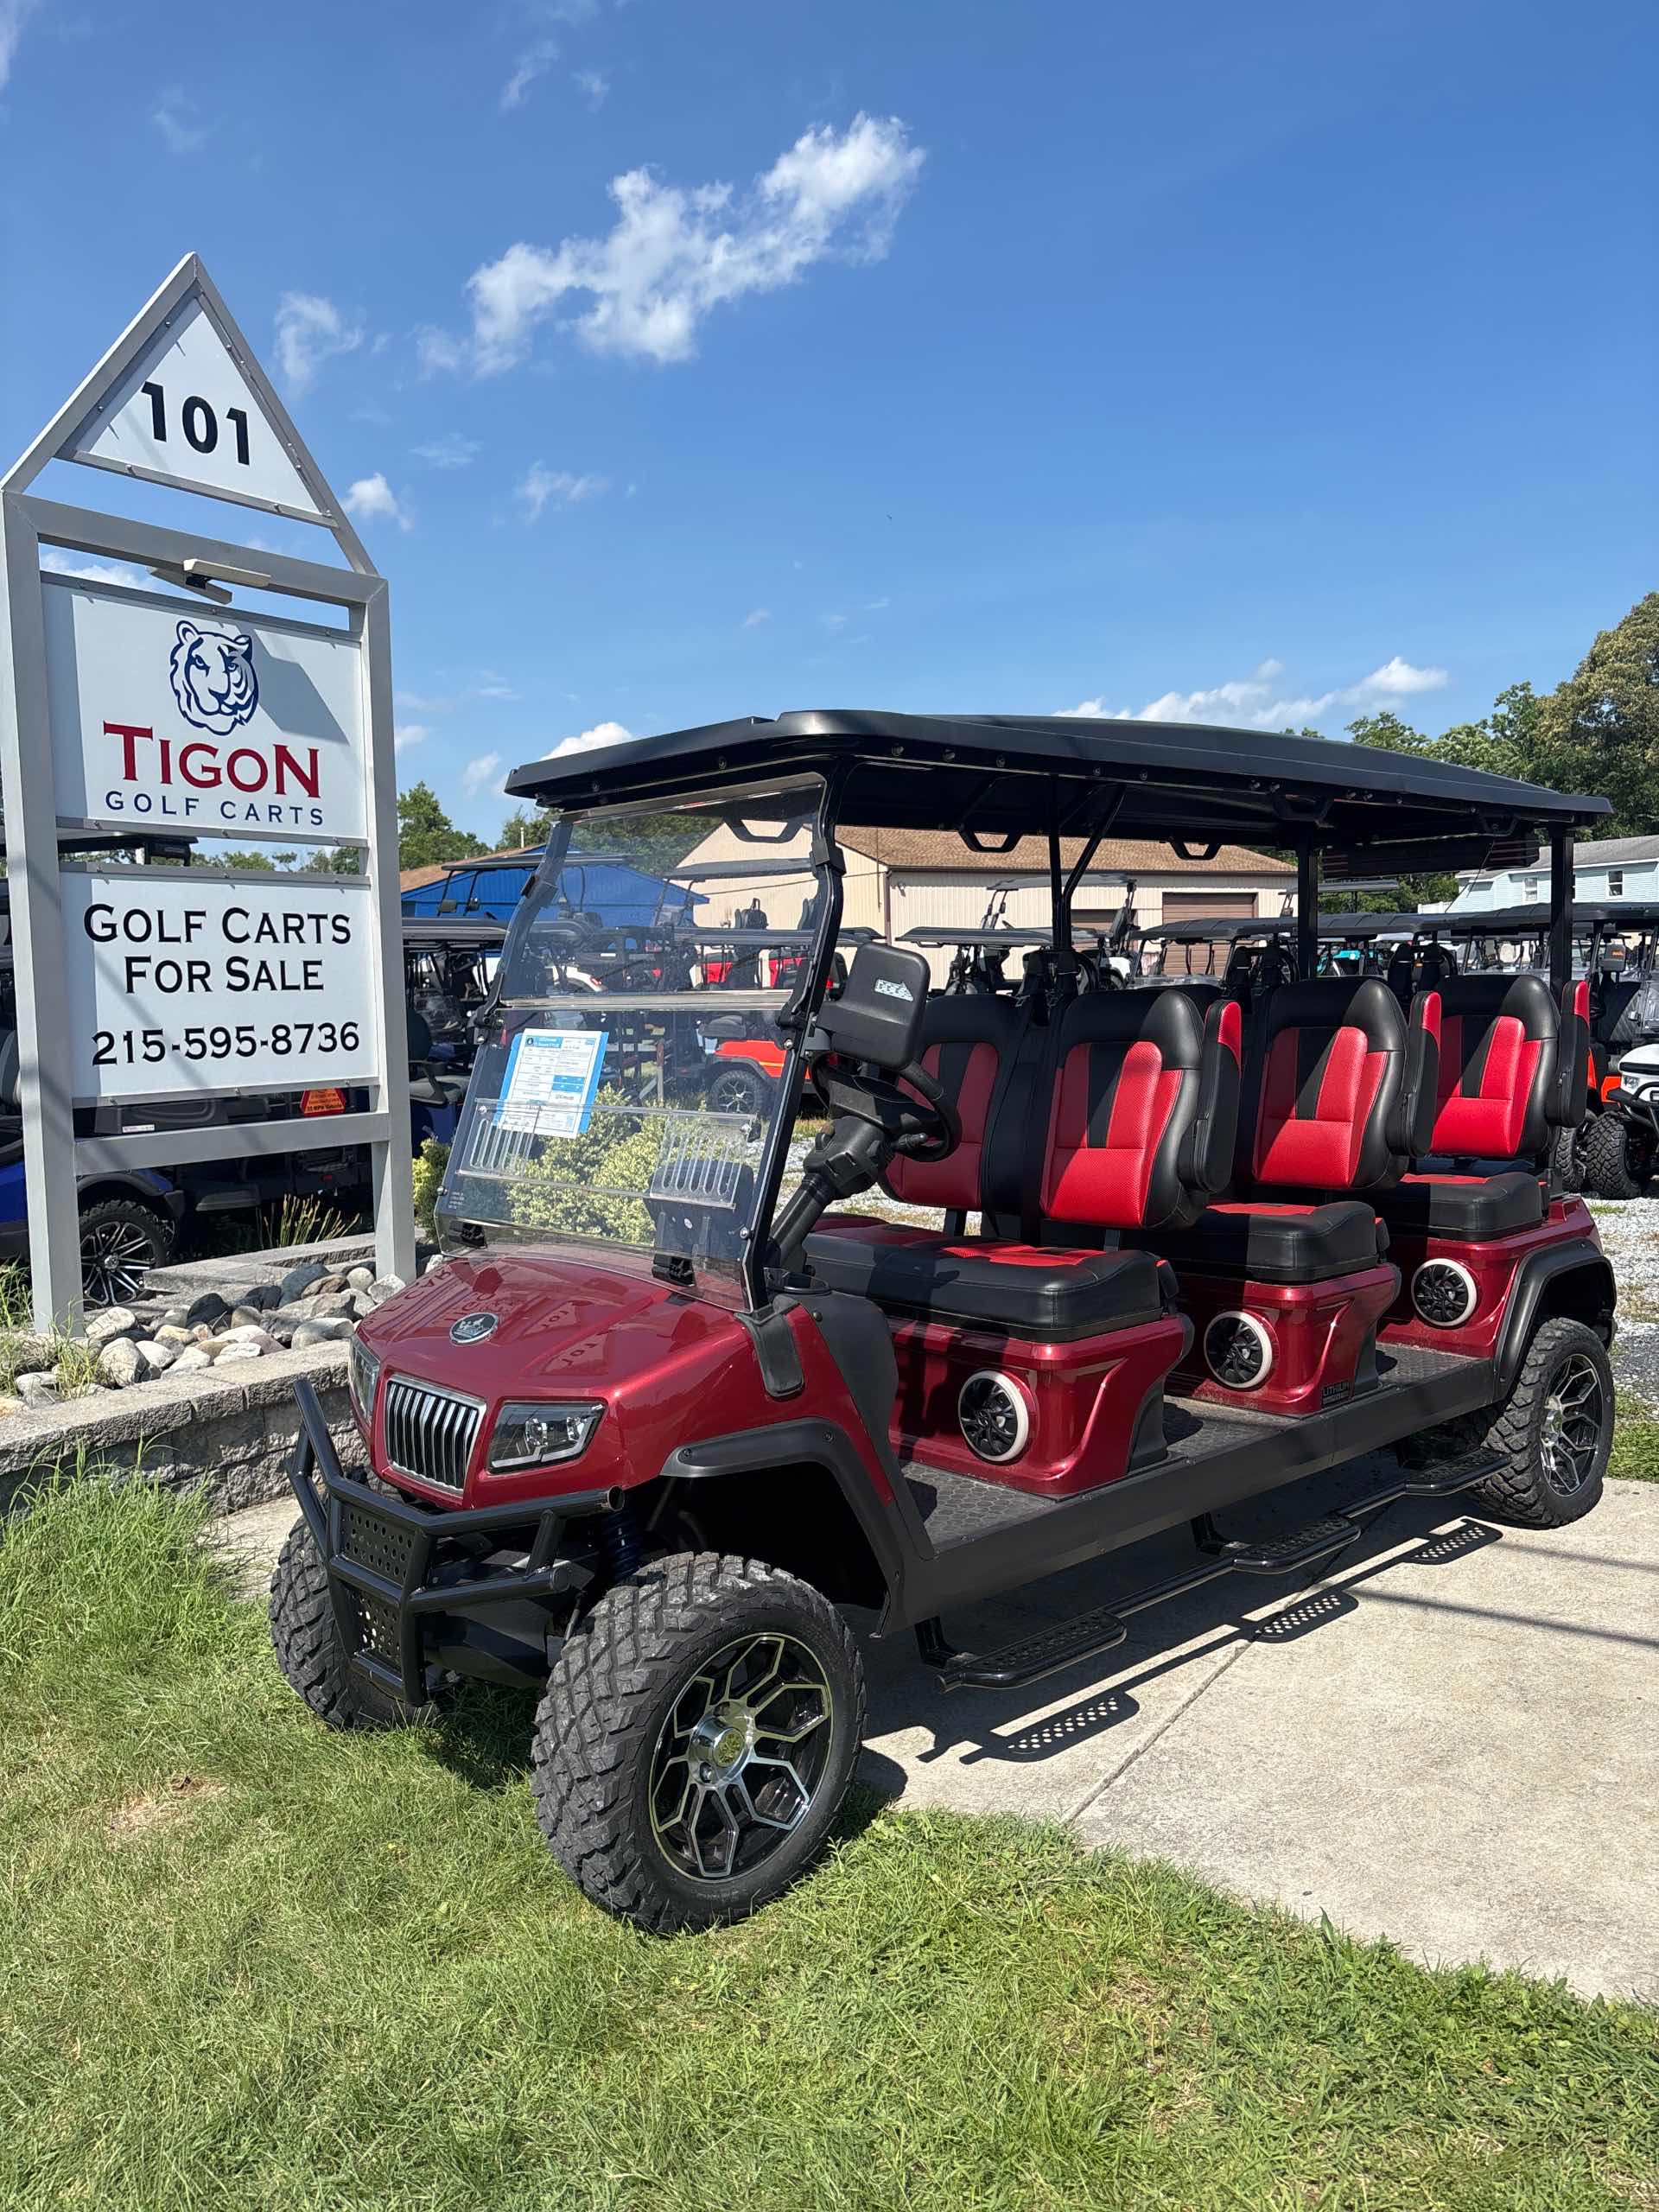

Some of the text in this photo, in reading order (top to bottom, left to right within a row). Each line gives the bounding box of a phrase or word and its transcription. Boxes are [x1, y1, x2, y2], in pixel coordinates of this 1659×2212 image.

[140, 380, 250, 466] 101
[103, 720, 321, 798] TIGON
[105, 790, 324, 826] GOLF CARTS
[84, 903, 352, 944] GOLF CARTS
[124, 955, 324, 995] FOR SALE
[92, 1021, 360, 1067] 215-595-8736
